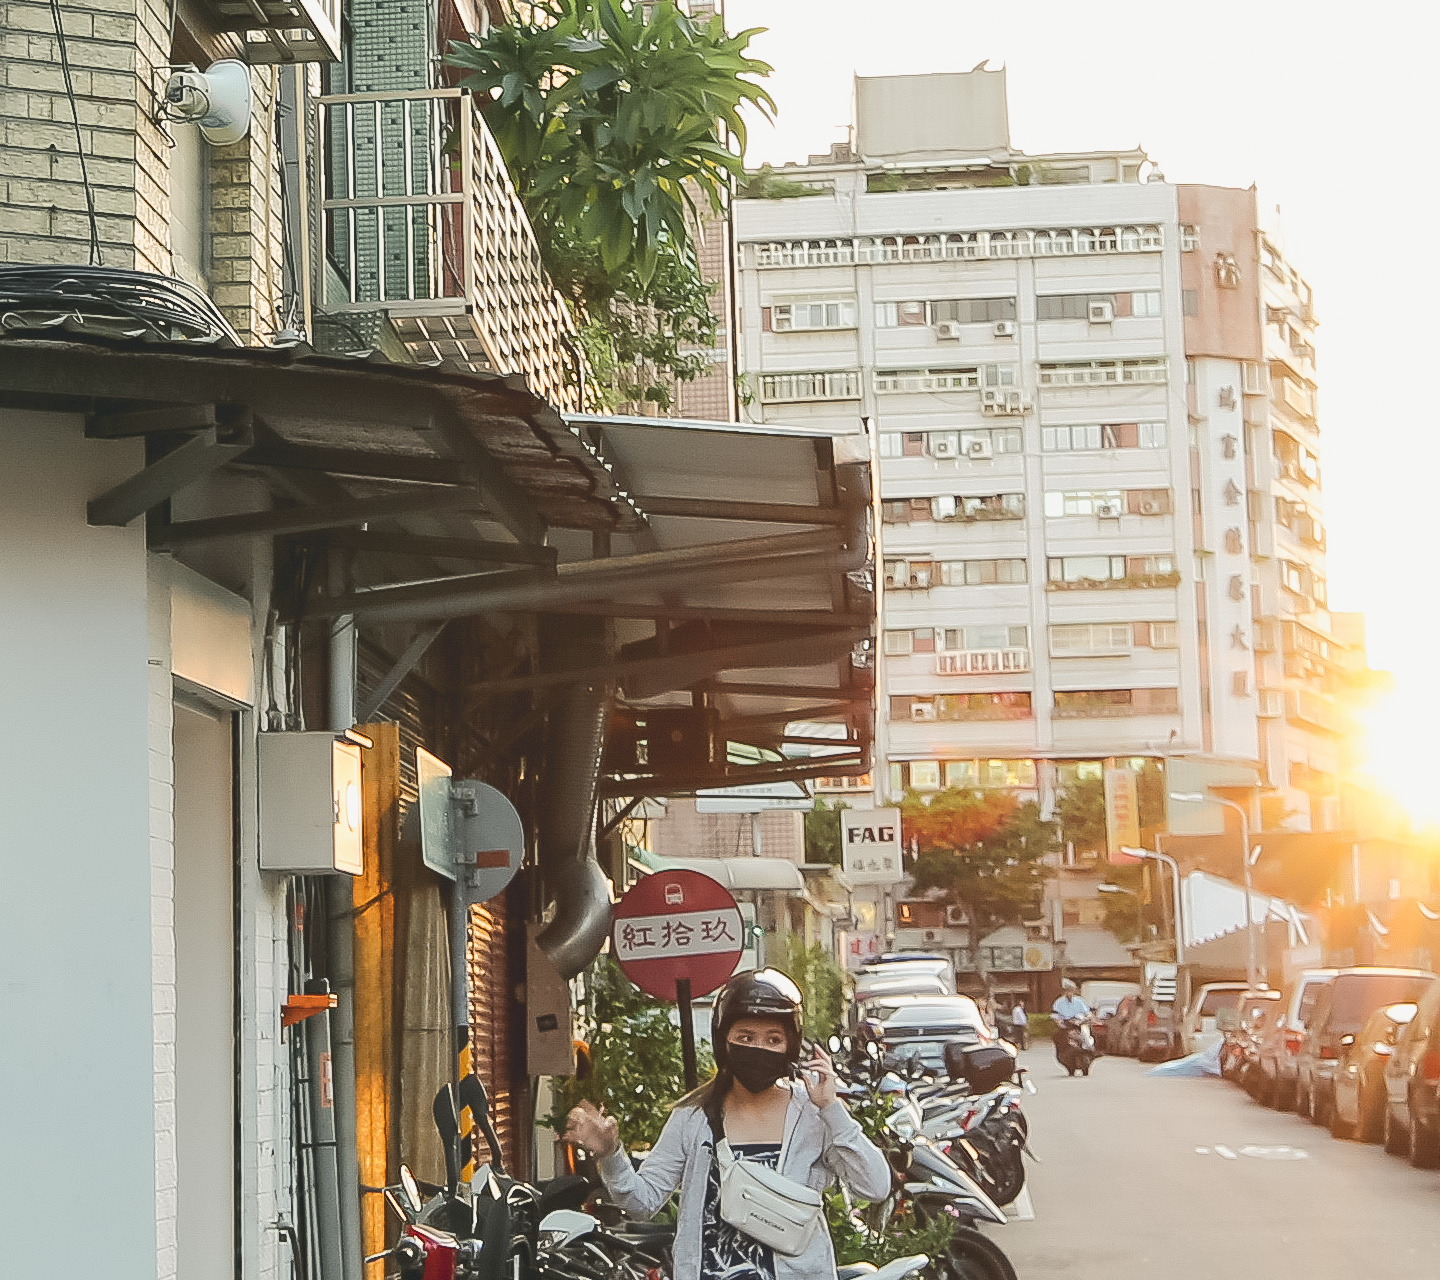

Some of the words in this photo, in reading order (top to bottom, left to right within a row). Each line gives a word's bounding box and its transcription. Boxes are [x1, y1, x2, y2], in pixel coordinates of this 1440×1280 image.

[848, 826, 894, 844] FAG
[622, 916, 736, 952] 紅拾玖
